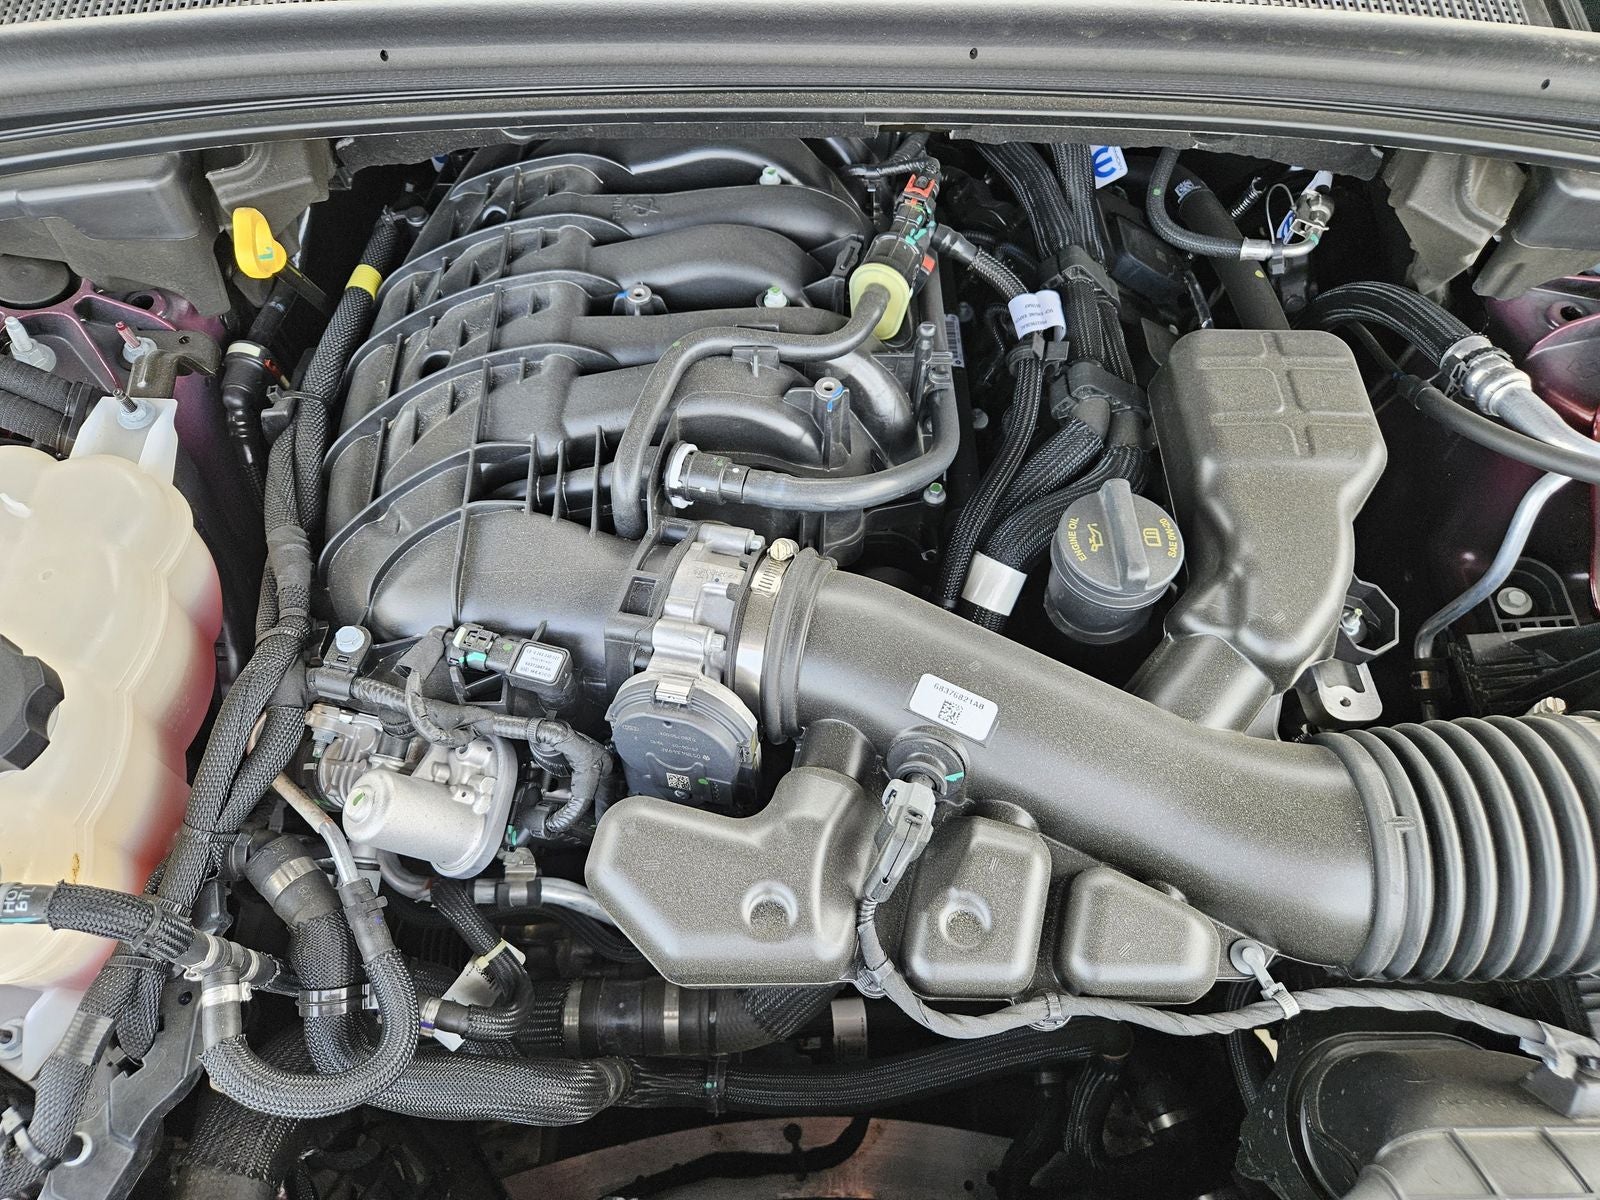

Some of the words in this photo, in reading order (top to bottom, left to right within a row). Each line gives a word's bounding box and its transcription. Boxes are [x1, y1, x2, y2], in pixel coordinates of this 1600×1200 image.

[1068, 517, 1079, 530] OIL
[1160, 518, 1177, 541] 0W-20
[1067, 531, 1087, 561] ENGINE
[1167, 541, 1178, 558] SAE
[933, 682, 985, 710] 68376821AB
[3, 886, 22, 913] HO
